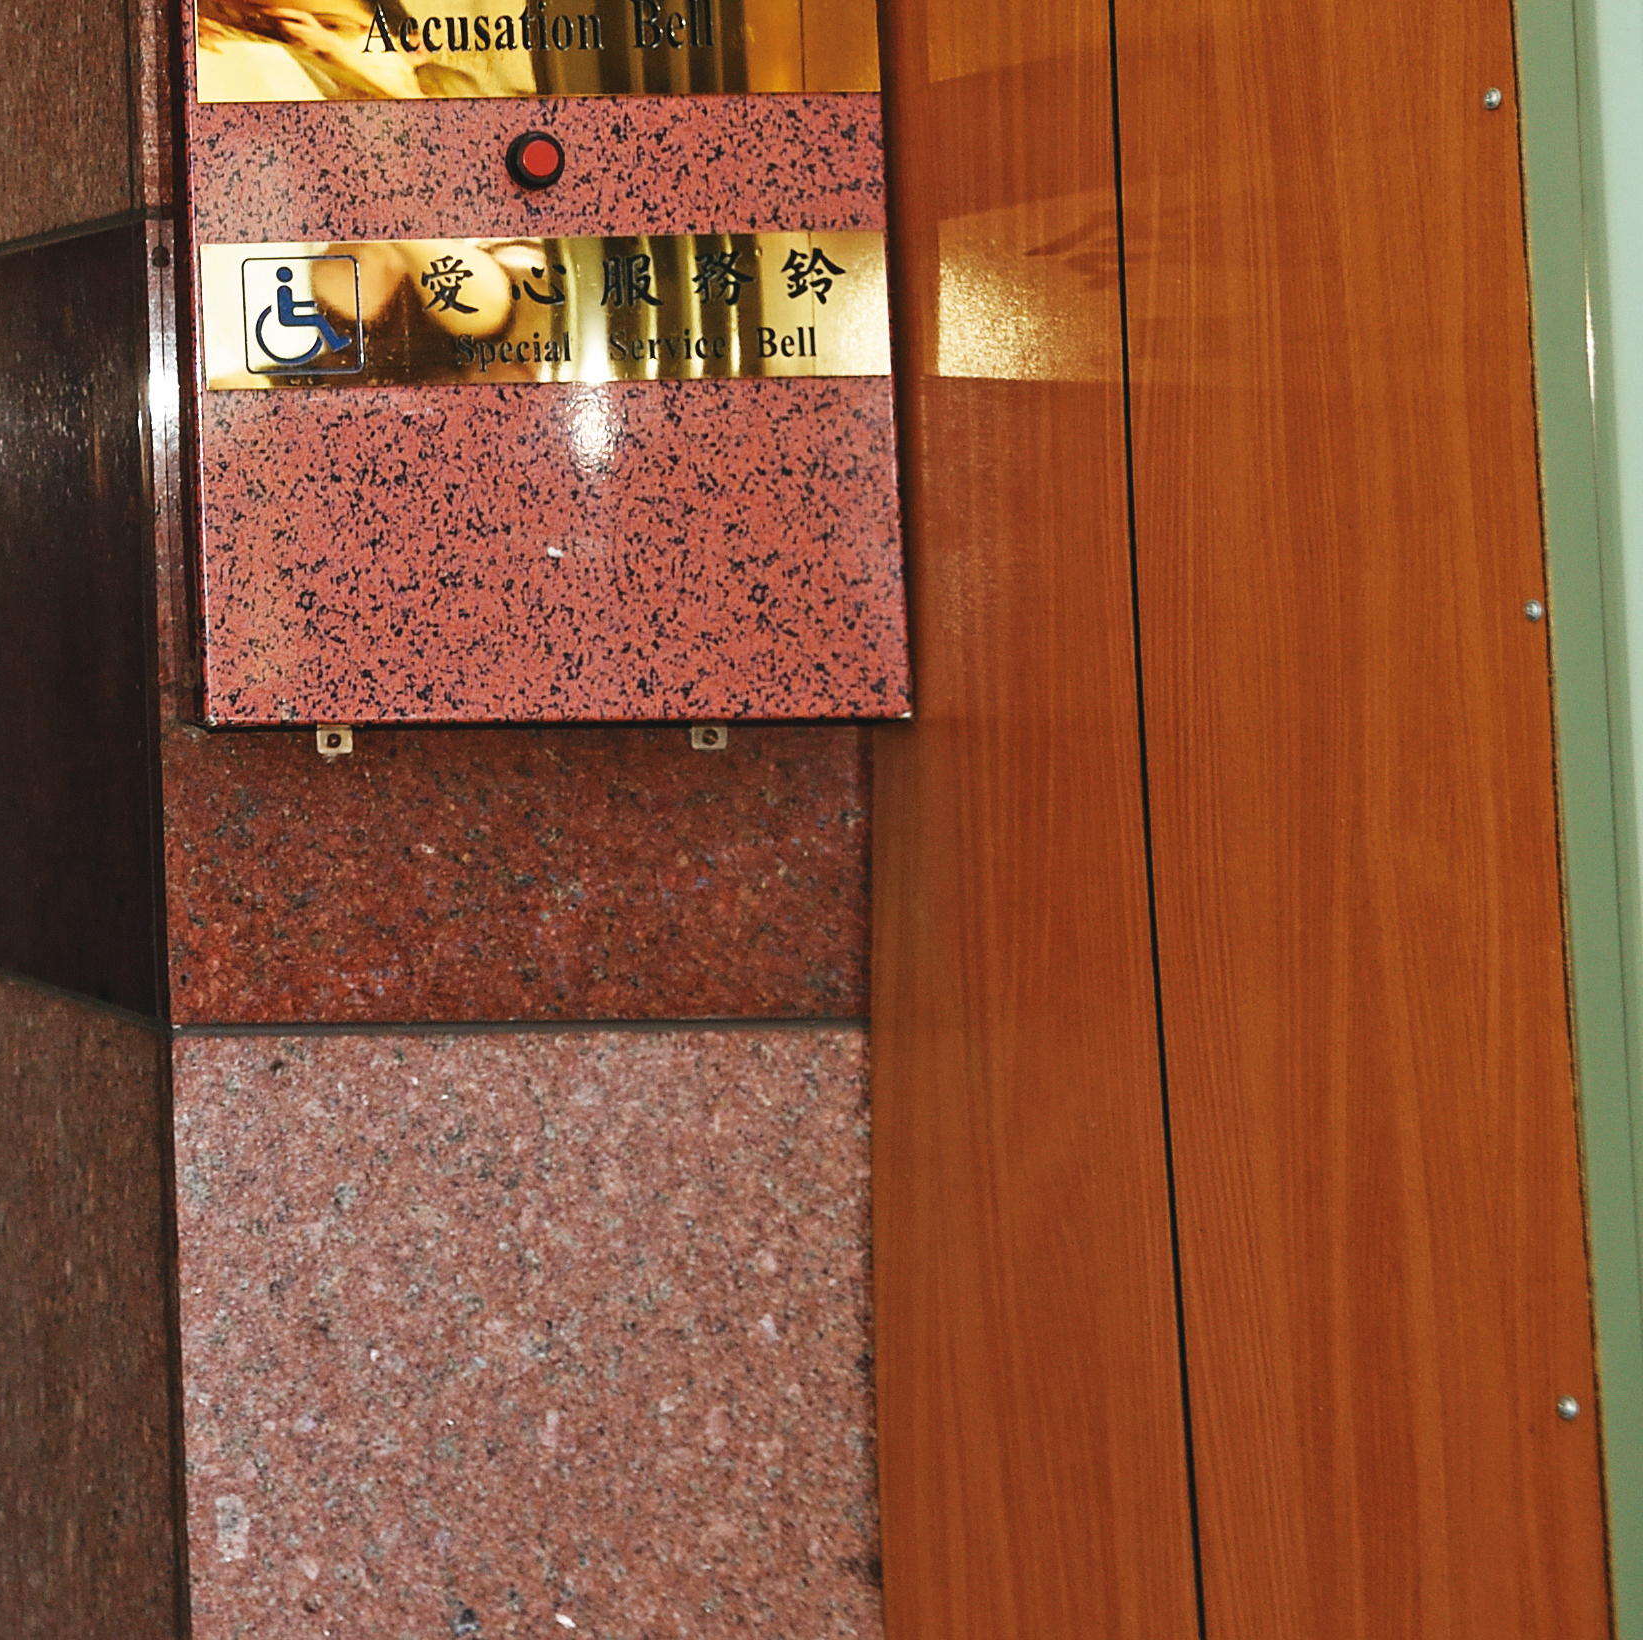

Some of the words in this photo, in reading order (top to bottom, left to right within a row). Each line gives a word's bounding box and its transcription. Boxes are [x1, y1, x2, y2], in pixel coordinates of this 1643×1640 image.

[361, 0, 605, 54] Accusation
[421, 247, 847, 314] 愛心服務鈴
[457, 331, 573, 372] Special
[609, 327, 727, 361] Service
[756, 326, 819, 358] Bell
